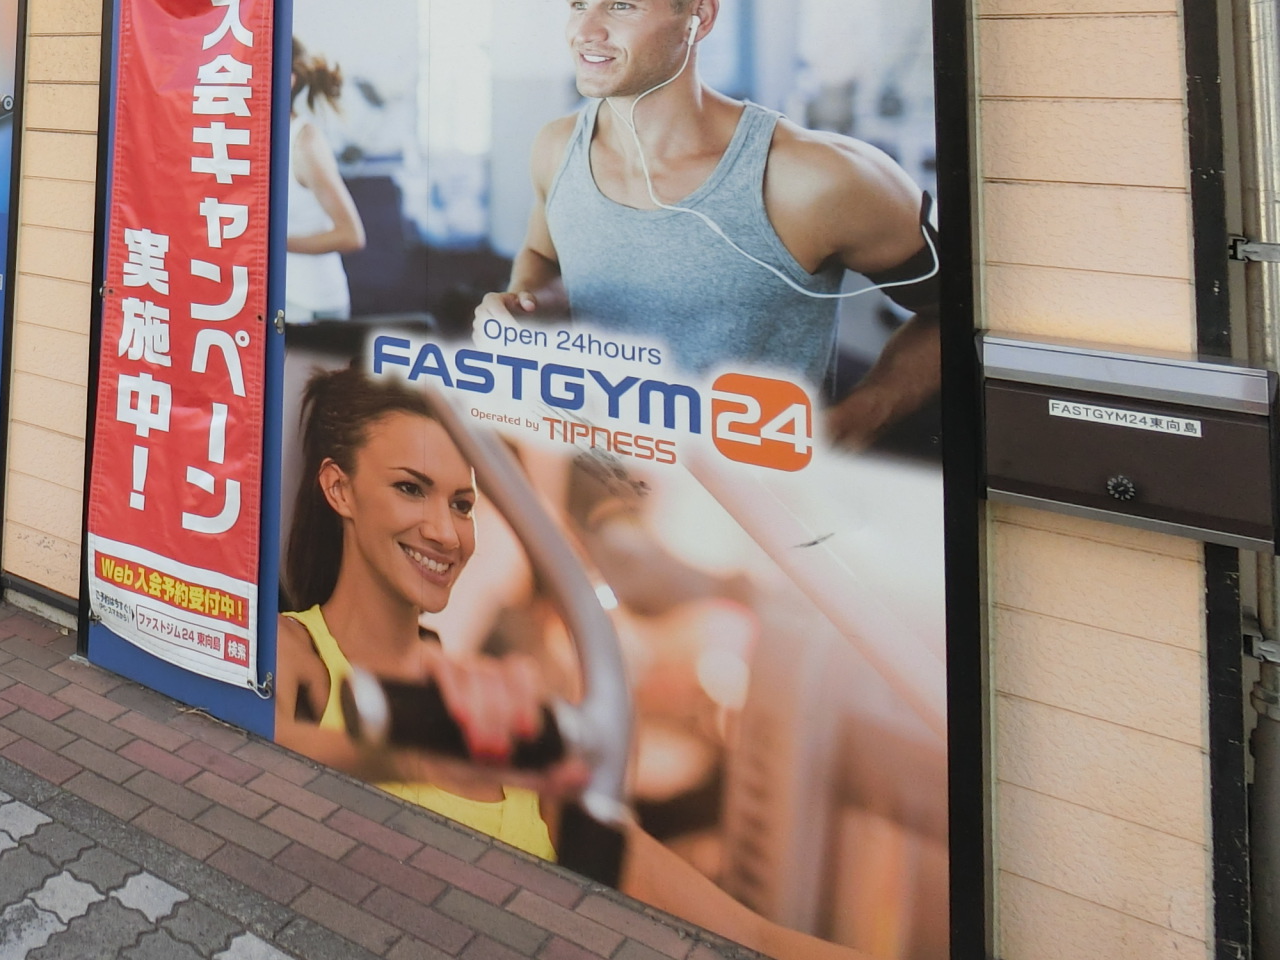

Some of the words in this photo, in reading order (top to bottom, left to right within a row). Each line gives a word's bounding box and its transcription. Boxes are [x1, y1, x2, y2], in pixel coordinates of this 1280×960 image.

[483, 318, 549, 348] Open
[556, 329, 663, 366] 24hours
[114, 227, 173, 512] 実施中!
[373, 334, 703, 436] FASTGYM
[711, 388, 814, 456] 24
[470, 406, 522, 427] Operated
[525, 418, 540, 432] by
[542, 416, 678, 466] TIPNESS
[1051, 402, 1199, 436] FASTGYM24東向島
[100, 556, 134, 586] Web
[197, 634, 222, 651] 東向島
[227, 639, 248, 661] 検索
